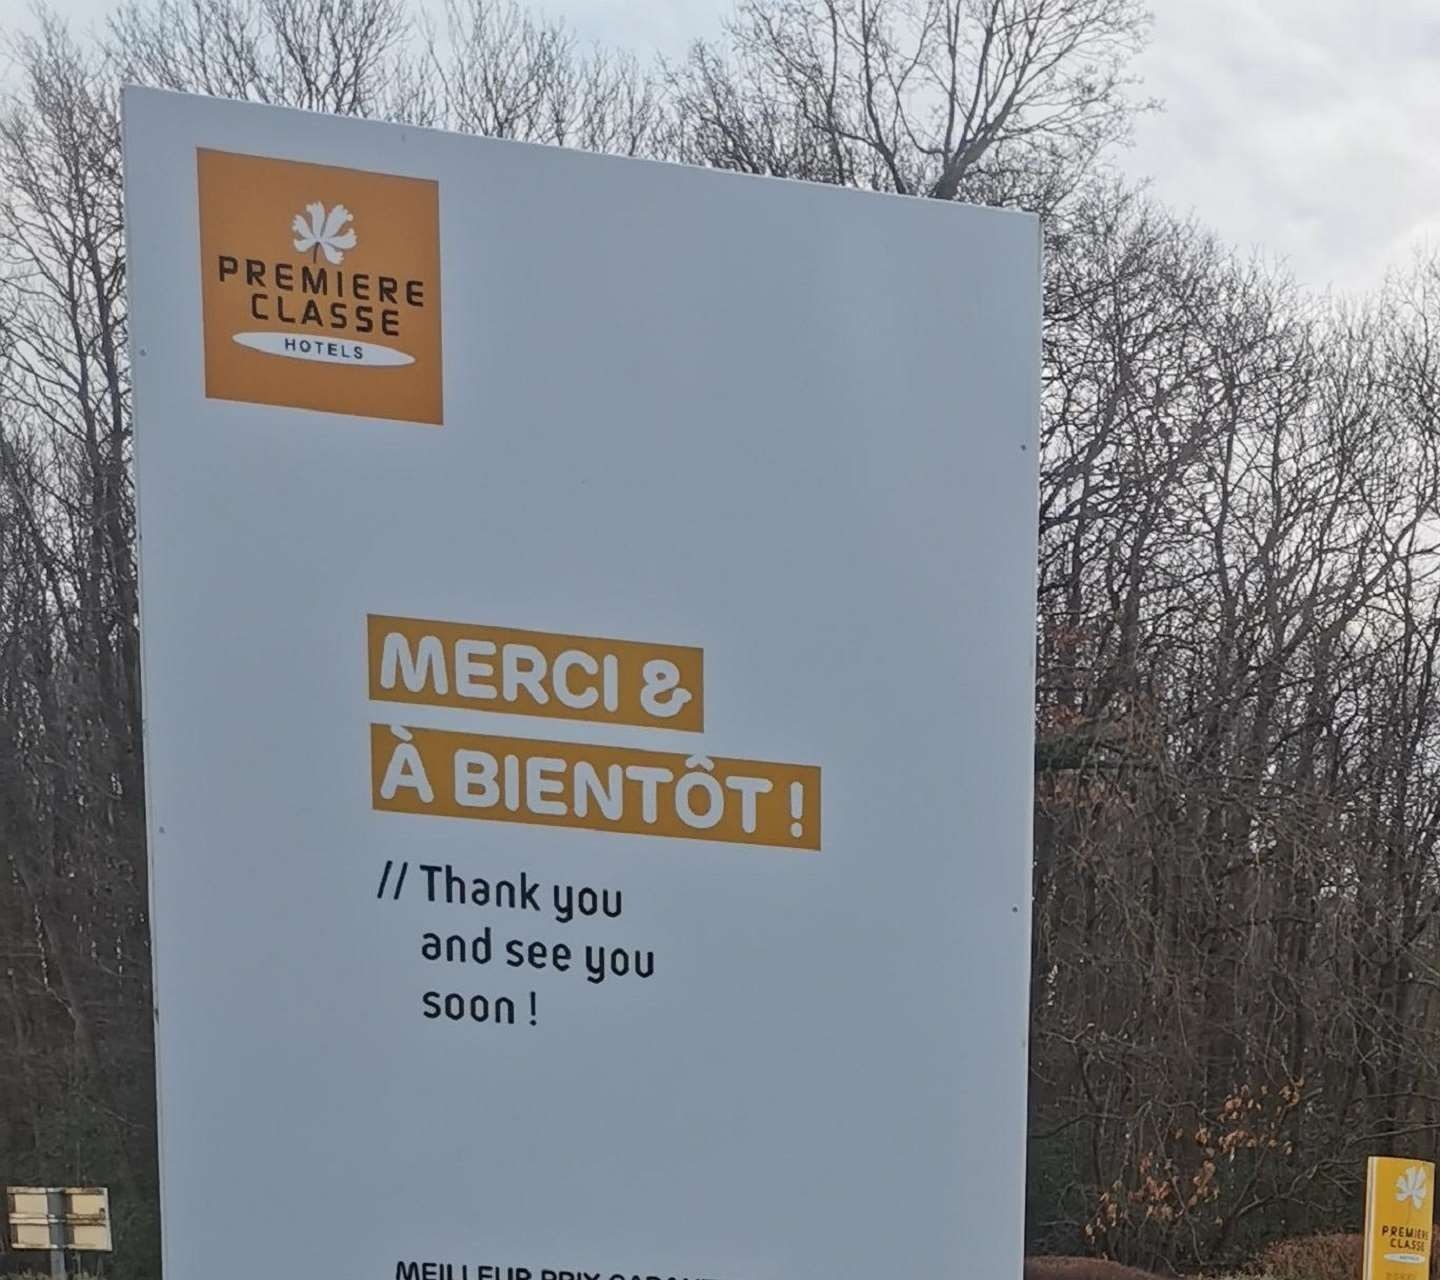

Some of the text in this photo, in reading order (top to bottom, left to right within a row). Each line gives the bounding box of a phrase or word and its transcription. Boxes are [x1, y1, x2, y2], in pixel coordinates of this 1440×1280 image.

[219, 256, 425, 307] PREMIERE
[251, 293, 400, 336] CLASSE
[284, 337, 364, 360] HOTELS
[379, 631, 692, 718] MERCI &
[379, 725, 804, 838] À BIENTÔT !
[419, 864, 542, 911] Thank
[553, 888, 623, 924] you
[421, 926, 655, 984] and see you
[422, 990, 537, 1026] soon !
